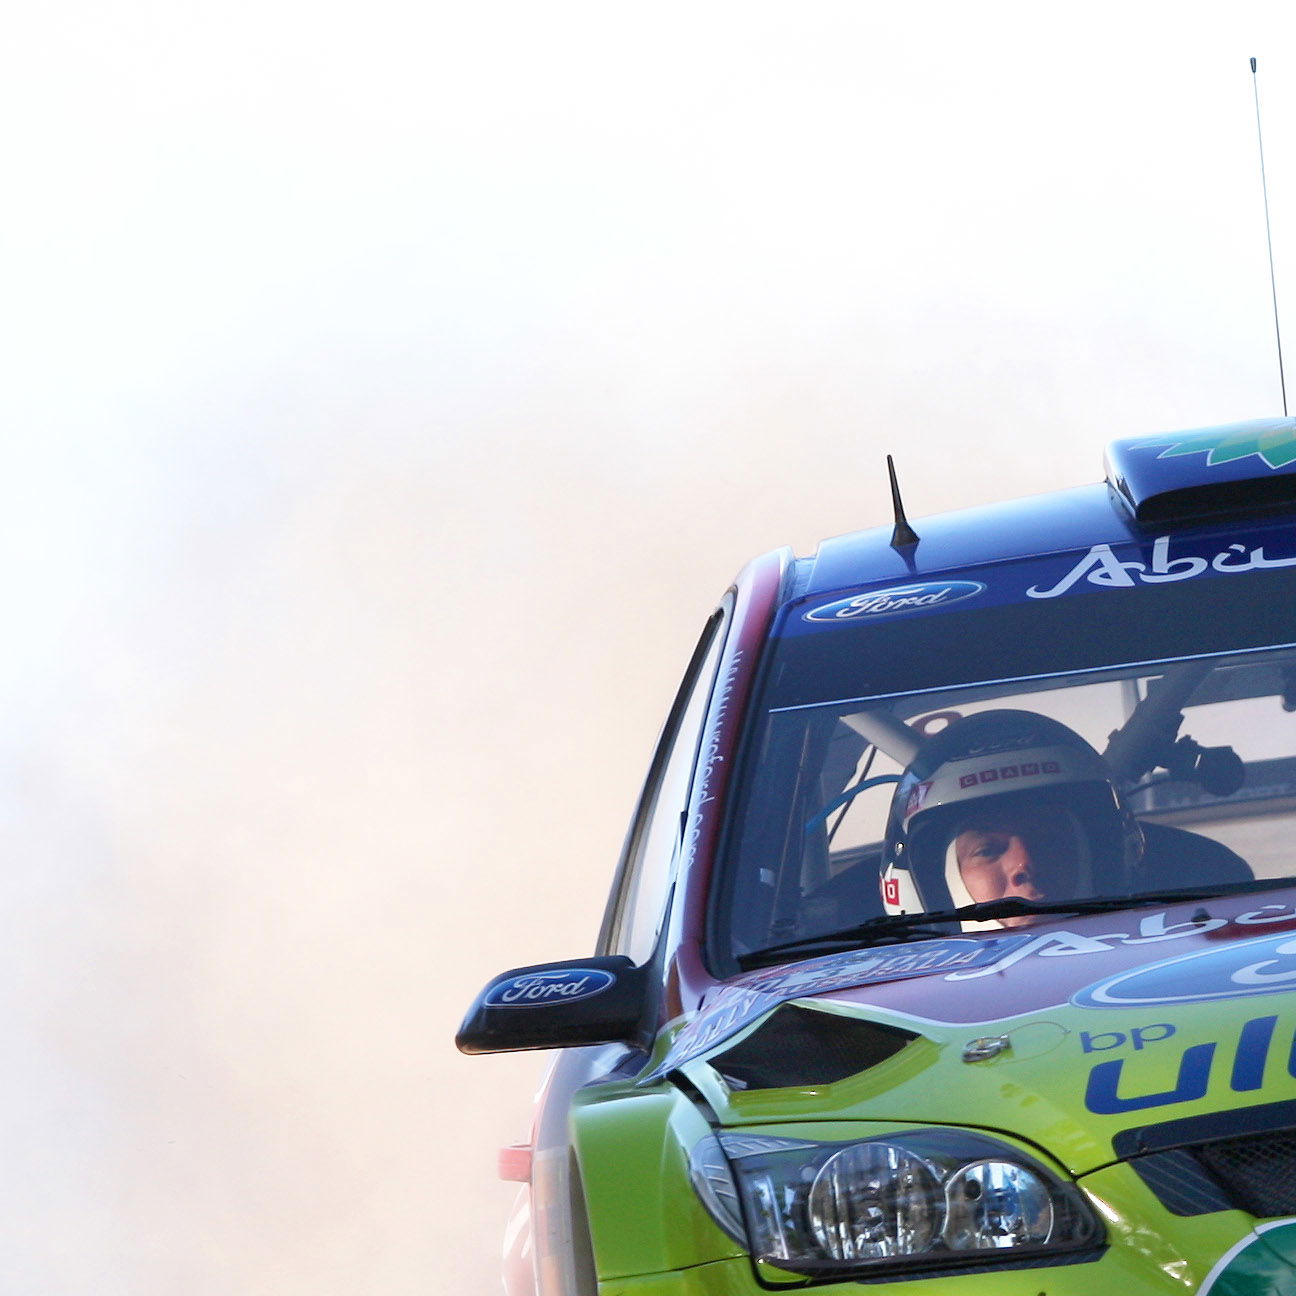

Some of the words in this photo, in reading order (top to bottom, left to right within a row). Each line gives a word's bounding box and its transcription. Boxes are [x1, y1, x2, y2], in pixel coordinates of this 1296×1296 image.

[837, 586, 955, 618] Ford
[501, 972, 590, 1003] Ford
[1081, 1022, 1177, 1055] bp
